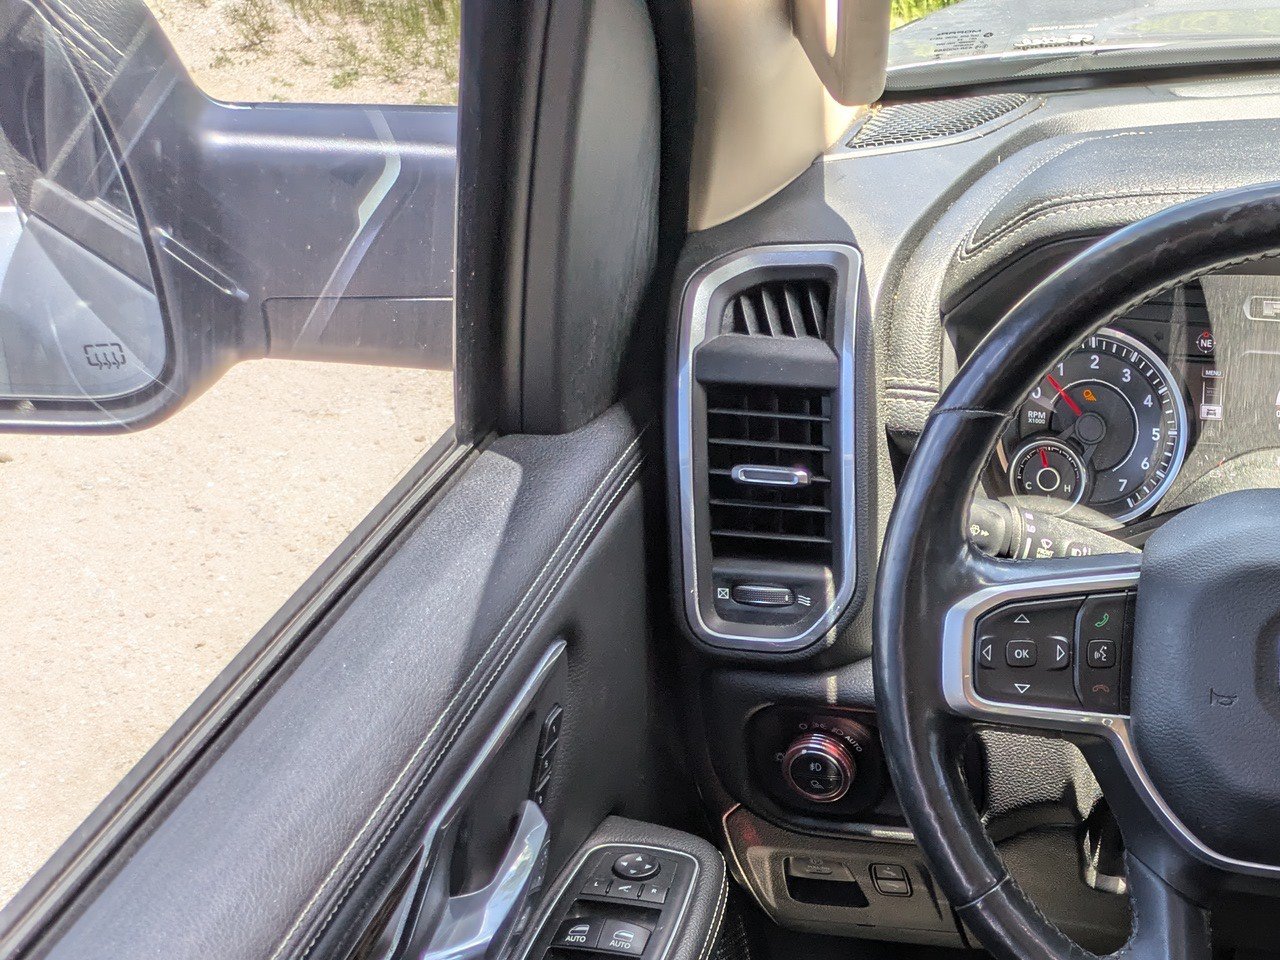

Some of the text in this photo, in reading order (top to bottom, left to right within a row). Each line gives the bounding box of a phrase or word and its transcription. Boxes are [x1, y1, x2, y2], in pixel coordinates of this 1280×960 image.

[1201, 340, 1212, 348] NE
[1091, 355, 1099, 369] 2
[1058, 363, 1064, 376] 1
[1122, 368, 1131, 382] 3
[1143, 395, 1153, 407] 4
[1152, 428, 1160, 441] 5
[1141, 457, 1150, 470] 6
[1025, 482, 1032, 490] C
[1064, 484, 1071, 492] H
[1119, 479, 1128, 492] 7
[1015, 649, 1029, 659] OK
[844, 735, 862, 752] AUTO
[610, 940, 631, 949] AUTO
